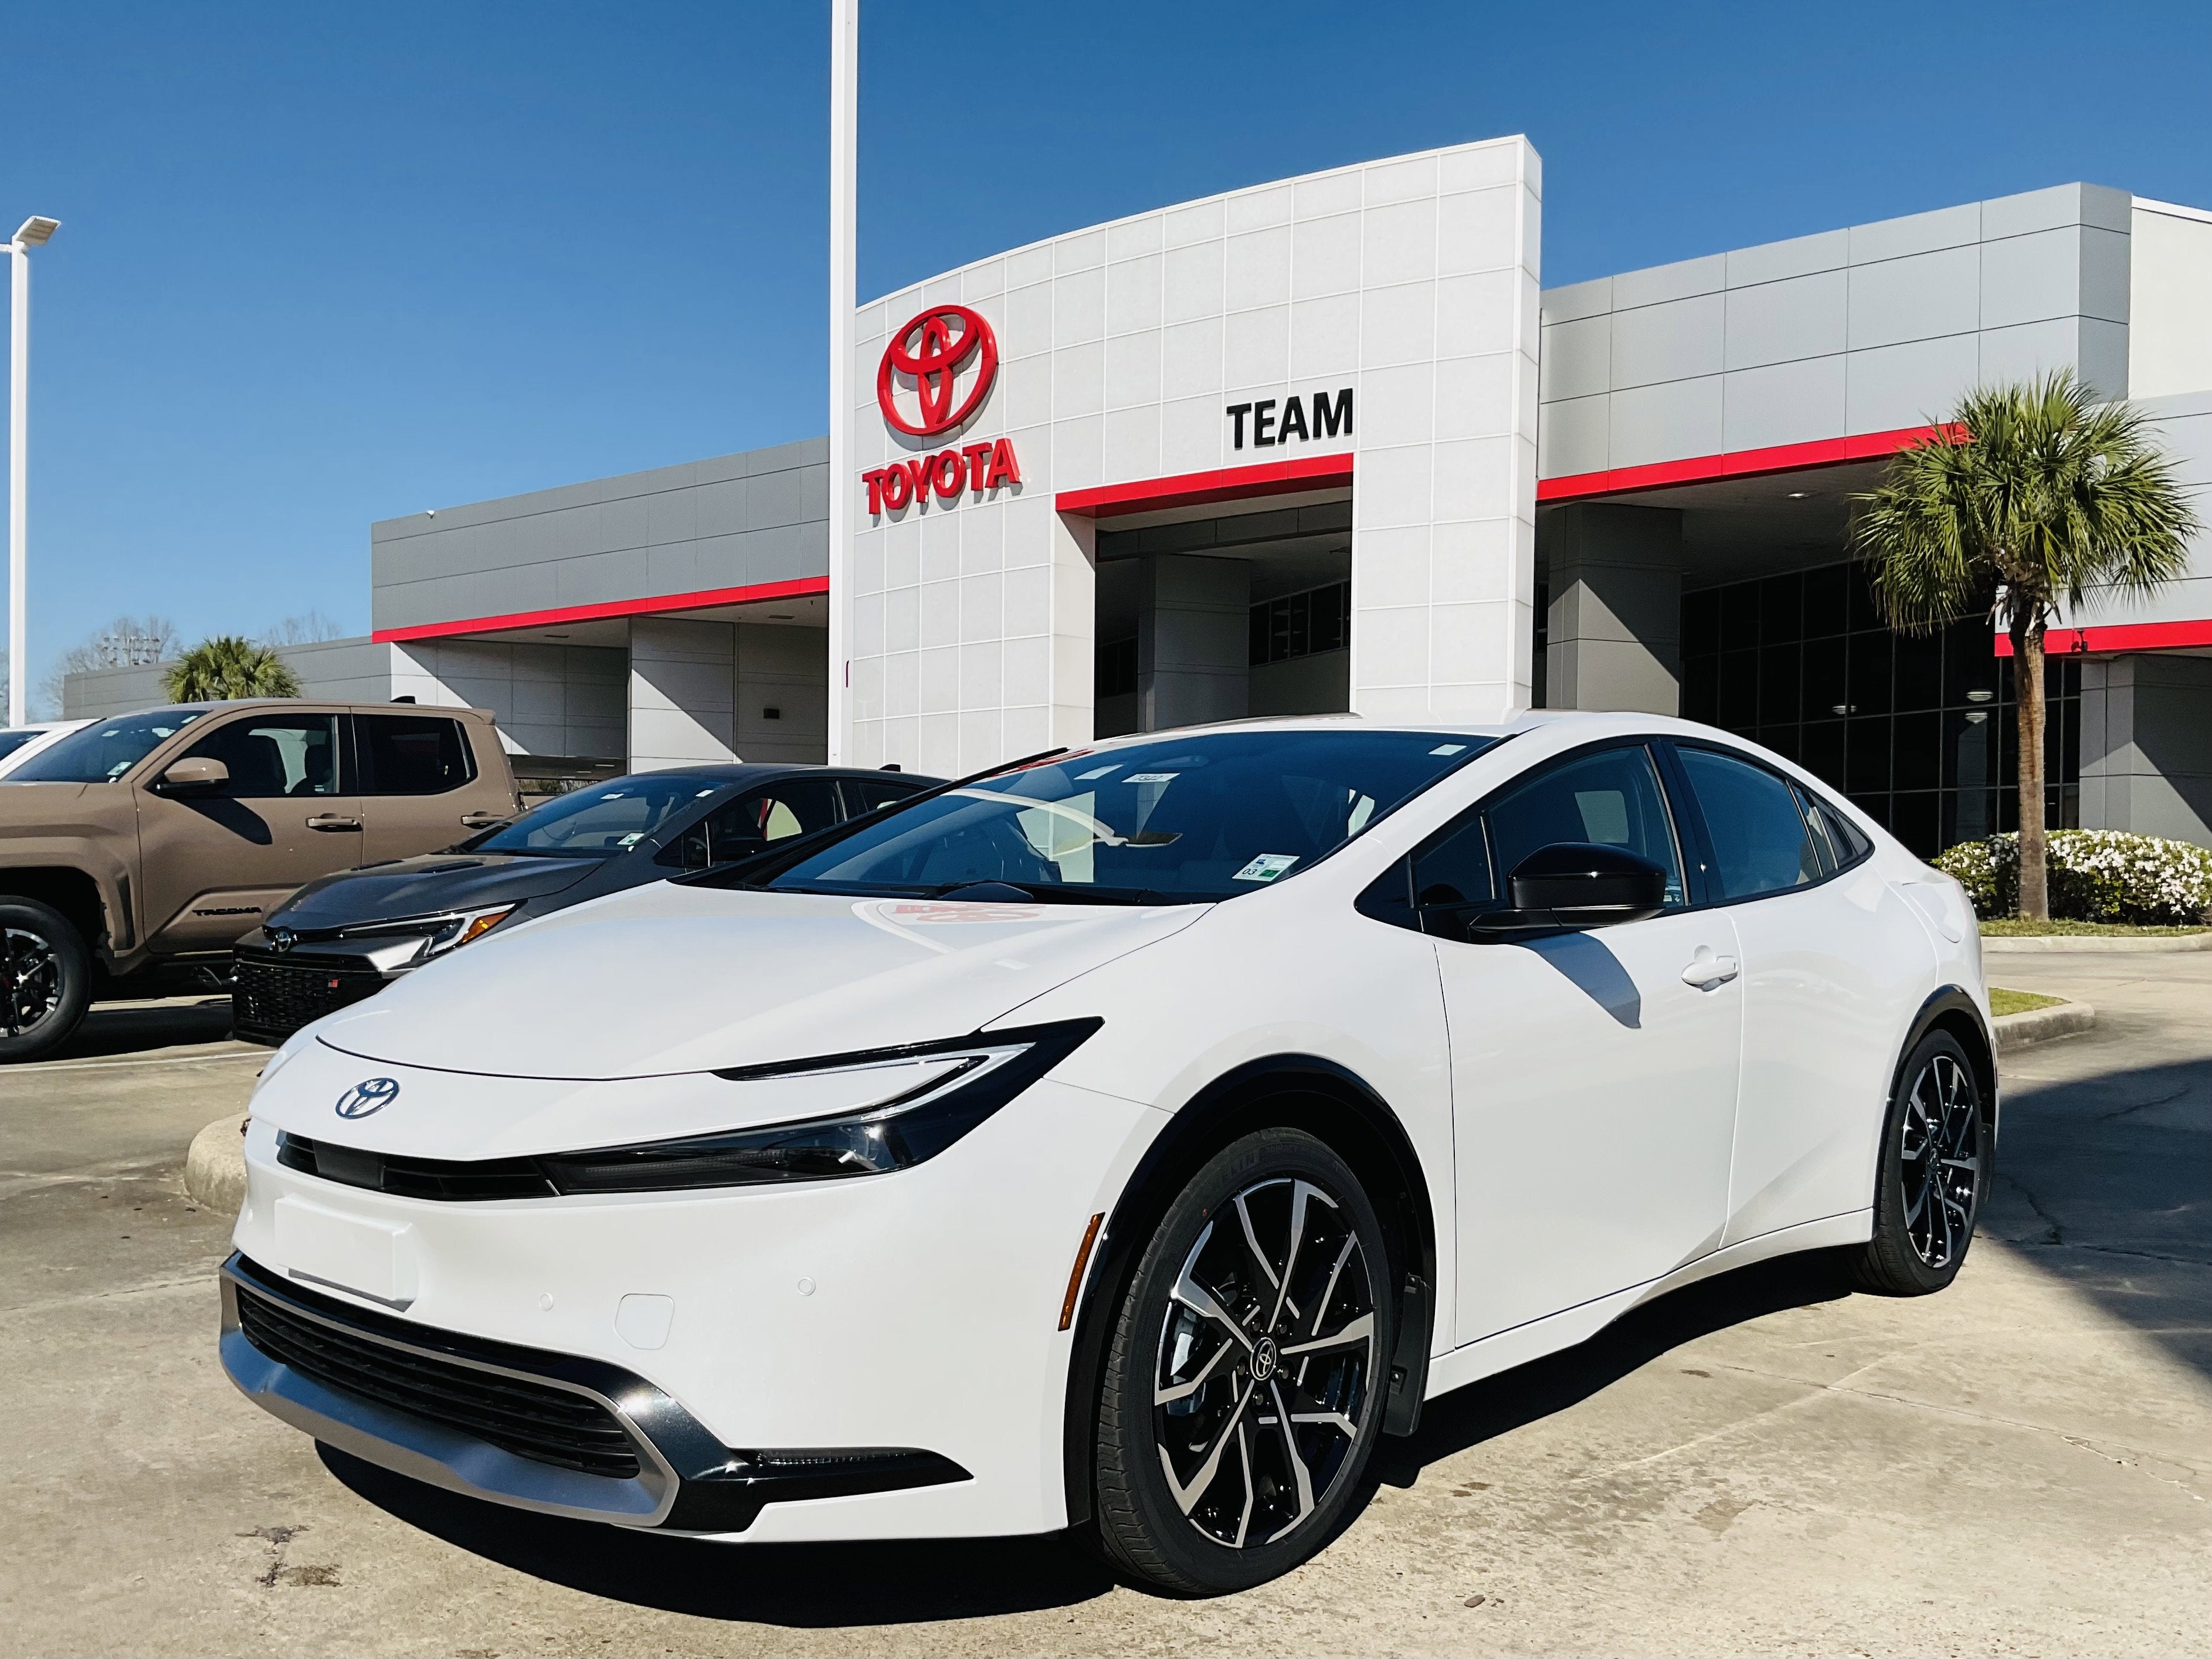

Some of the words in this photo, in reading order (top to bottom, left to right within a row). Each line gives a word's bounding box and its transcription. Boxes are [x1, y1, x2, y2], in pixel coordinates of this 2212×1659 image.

[1226, 388, 1353, 448] TEAM
[862, 438, 1022, 514] TOYOTA
[192, 907, 262, 916] TACOMA
